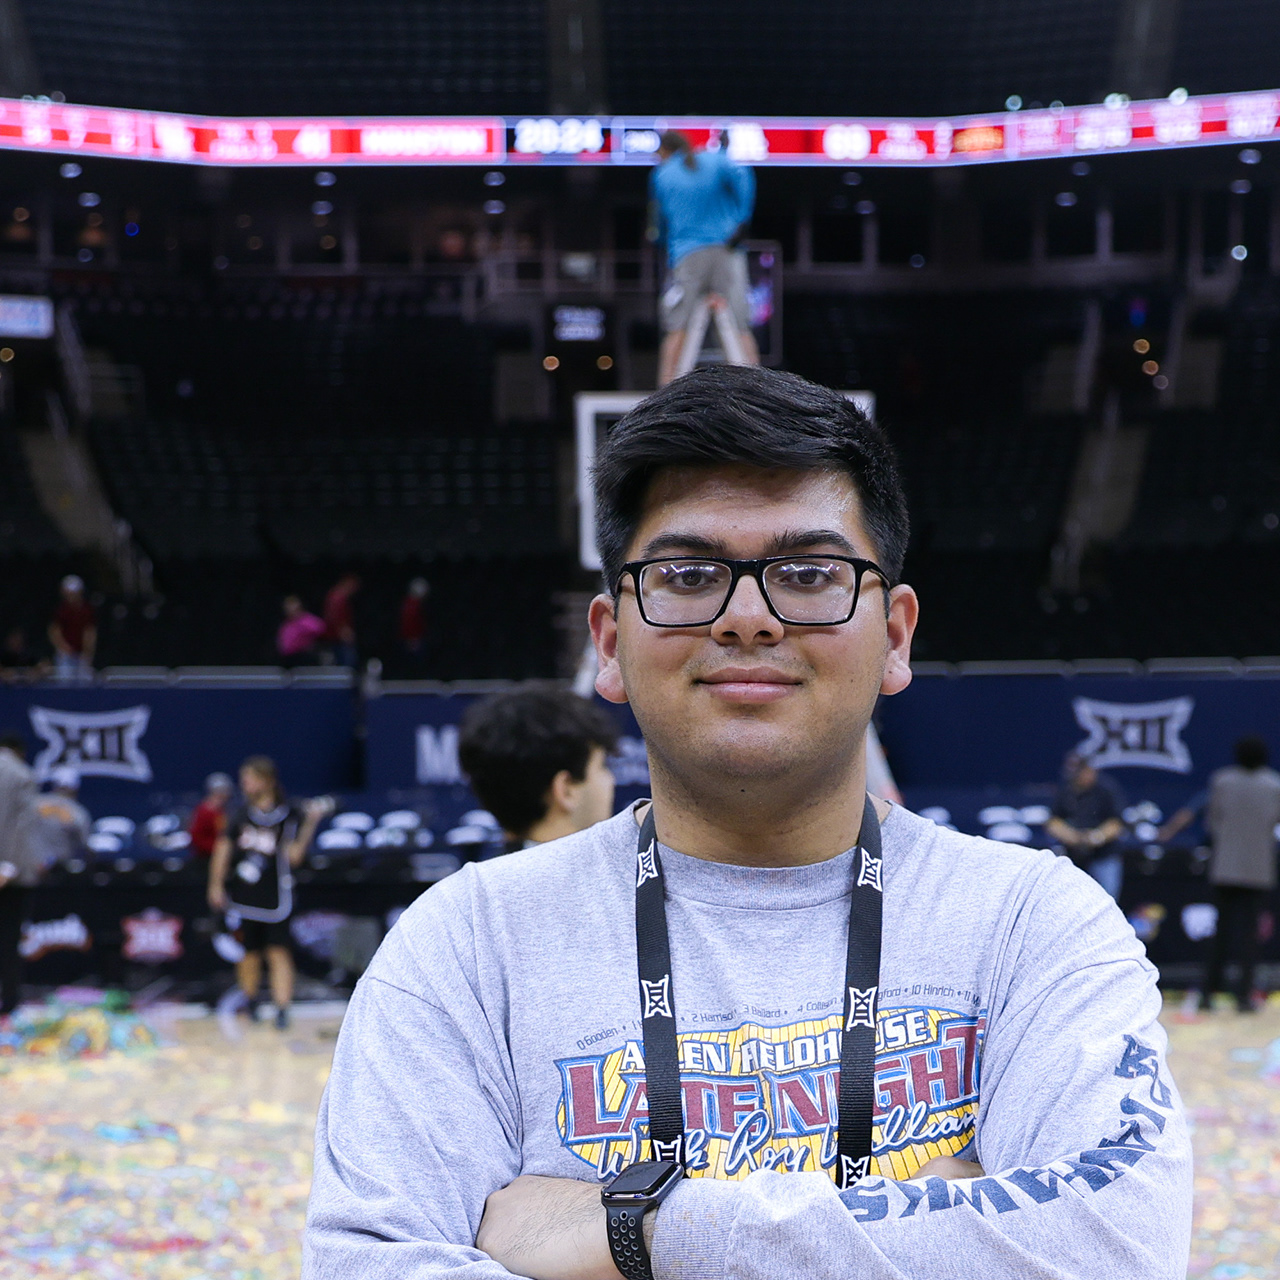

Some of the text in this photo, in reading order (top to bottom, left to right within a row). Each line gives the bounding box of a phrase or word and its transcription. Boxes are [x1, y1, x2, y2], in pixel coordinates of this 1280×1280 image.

[923, 984, 955, 997] Hinrich
[700, 1008, 737, 1022] Harriso
[620, 1009, 929, 1073] AEN FIELDHUSE
